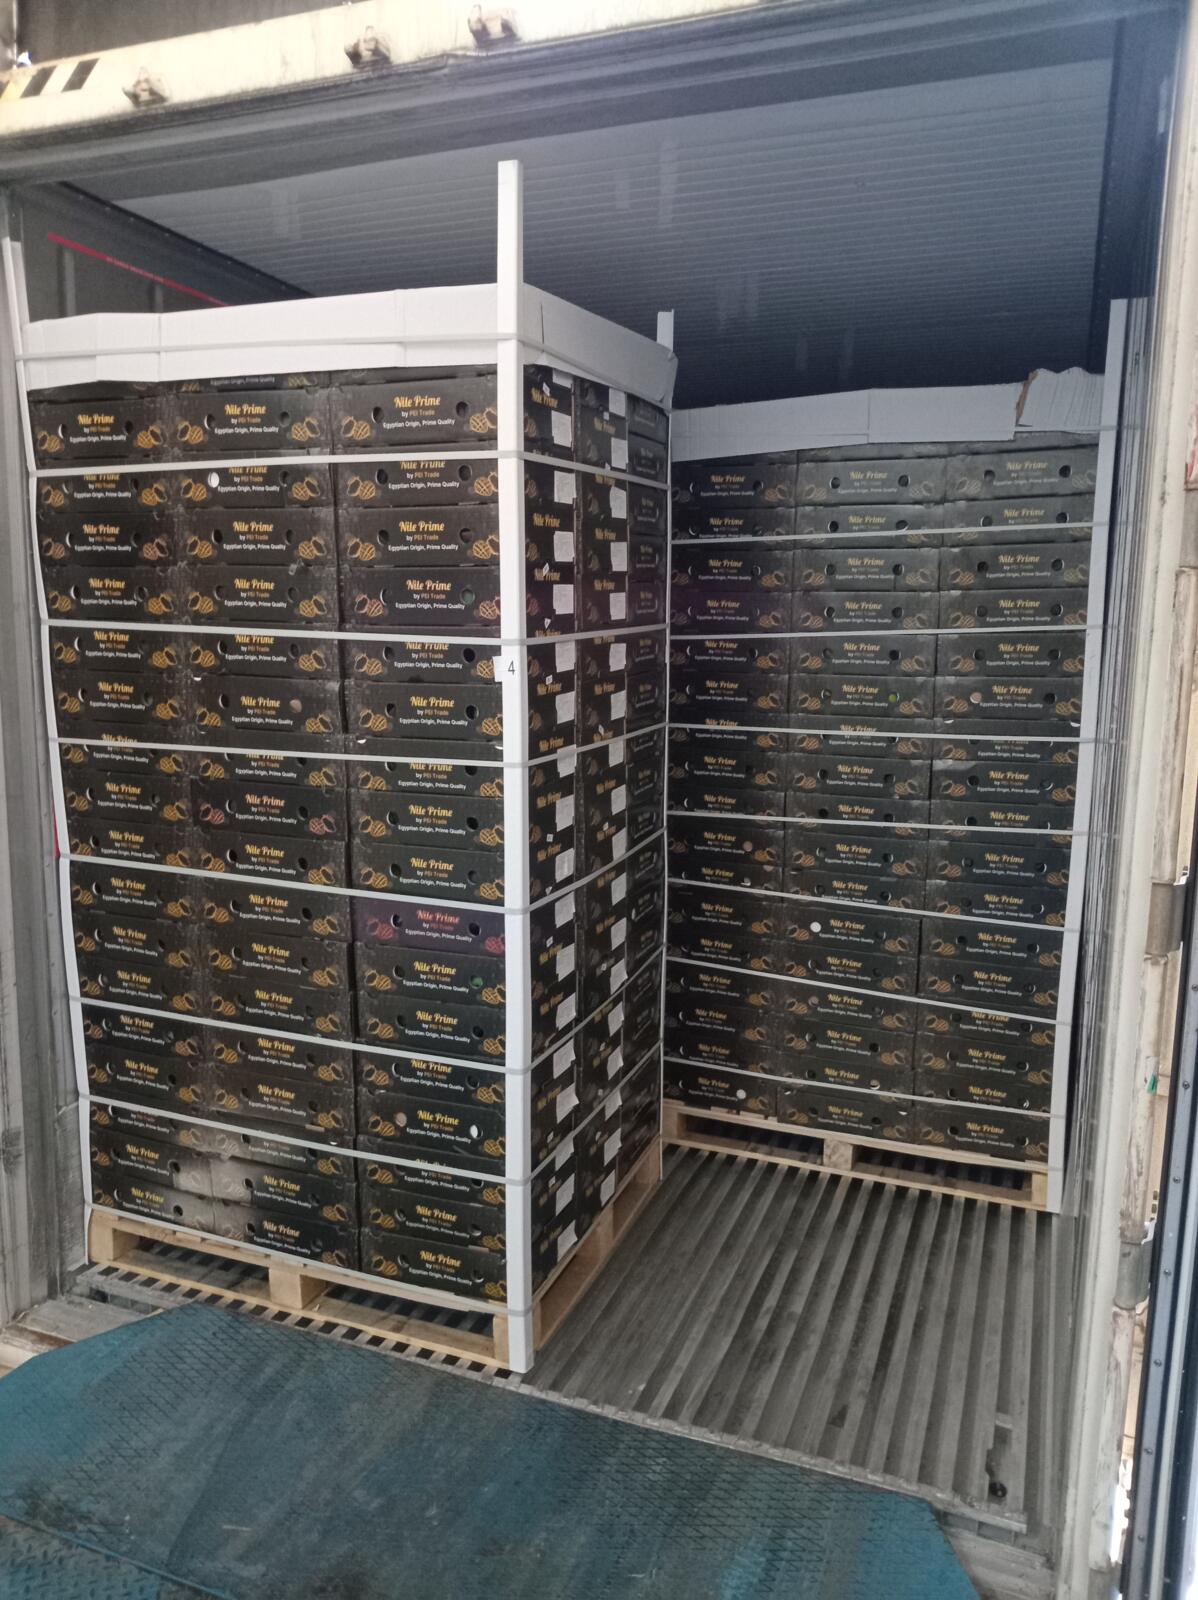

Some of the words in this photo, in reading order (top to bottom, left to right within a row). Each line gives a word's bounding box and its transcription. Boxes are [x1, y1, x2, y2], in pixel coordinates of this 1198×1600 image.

[394, 396, 412, 408] Nile
[414, 394, 441, 407] Prime
[225, 404, 241, 415] Nile
[242, 403, 266, 415] Prime
[78, 414, 92, 425] Nile
[93, 413, 115, 424] Prime
[383, 421, 405, 429] Egyptian
[437, 418, 455, 426] Quality
[215, 427, 234, 435] Egyptian
[710, 475, 724, 483] Nile
[724, 474, 746, 483] Prime
[83, 524, 97, 534] Nile
[98, 524, 120, 535] Prime
[233, 521, 248, 532] Nile
[250, 521, 274, 532] Prime
[399, 521, 416, 532] Nile
[418, 520, 445, 532] Prime
[441, 543, 458, 551] Quality
[708, 559, 722, 567] Nile
[722, 559, 743, 567] Prime
[846, 558, 862, 566] Nile
[862, 557, 886, 566] Prime
[998, 555, 1015, 563] Nile
[1015, 554, 1041, 563] Prime
[89, 578, 103, 588] Nile
[104, 578, 126, 589] Prime
[234, 578, 250, 589] Nile
[251, 579, 275, 590] Prime
[406, 579, 424, 591] Nile
[425, 579, 452, 591] Prime
[395, 602, 416, 610] Egyptian
[844, 601, 859, 610] Nile
[860, 601, 883, 610] Prime
[843, 642, 858, 651] Nile
[858, 643, 881, 651] Prime
[998, 643, 1015, 652] Nile
[1015, 643, 1041, 652] Prime
[507, 660, 516, 675] 4
[98, 681, 112, 692] Nile
[113, 682, 134, 694] Prime
[705, 680, 718, 688] Nile
[719, 680, 739, 689] Prime
[841, 684, 856, 693] Nile
[857, 685, 879, 694] Prime
[991, 685, 1008, 694] Nile
[1008, 685, 1033, 694] Prime
[241, 696, 256, 707] Nile
[257, 696, 281, 708] Prime
[410, 696, 427, 707] Nile
[429, 696, 455, 708] Prime
[399, 717, 420, 725] Egyptian
[837, 764, 852, 773] Nile
[852, 765, 874, 774] Prime
[988, 770, 1005, 779] Nile
[1005, 771, 1030, 780] Prime
[105, 782, 119, 792] Nile
[120, 783, 141, 795] Prime
[245, 794, 261, 805] Nile
[262, 795, 285, 807] Prime
[409, 804, 426, 816] Nile
[427, 805, 453, 818] Prime
[990, 811, 1006, 820] Nile
[1006, 812, 1031, 821] Prime
[398, 824, 419, 832] Egyptian
[449, 828, 466, 836] Quality
[835, 843, 850, 852] Nile
[850, 845, 873, 854] Prime
[410, 857, 427, 869] Nile
[428, 859, 454, 871] Prime
[984, 853, 1000, 862] Nile
[1001, 854, 1025, 864] Prime
[111, 877, 124, 888] Nile
[125, 879, 146, 891] Prime
[399, 877, 420, 885] Egyptian
[450, 881, 467, 889] Quality
[249, 894, 264, 905] Nile
[265, 895, 289, 908] Prime
[416, 909, 433, 921] Nile
[434, 911, 460, 925] Prime
[830, 919, 844, 928] Nile
[844, 920, 865, 930] Prime
[977, 932, 993, 941] Nile
[993, 934, 1018, 944] Prime
[252, 942, 267, 954] Nile
[268, 945, 290, 958] Prime
[826, 956, 841, 965] Nile
[841, 958, 863, 968] Prime
[414, 961, 430, 972] Nile
[431, 963, 457, 976] Prime
[117, 970, 130, 981] Nile
[131, 972, 152, 984] Prime
[973, 970, 989, 980] Nile
[989, 972, 1013, 983] Prime
[416, 1010, 432, 1022] Nile
[433, 1012, 459, 1026] Prime
[258, 1037, 272, 1049] Nile
[273, 1040, 296, 1053] Prime
[967, 1048, 983, 1058] Nile
[983, 1050, 1007, 1061] Prime
[125, 1059, 138, 1070] Nile
[139, 1062, 159, 1075] Prime
[418, 1110, 434, 1122] Nile
[435, 1112, 459, 1126] Prime
[263, 1175, 278, 1186] Nile
[279, 1178, 301, 1192] Prime
[416, 1205, 431, 1217] Nile
[433, 1208, 457, 1222] Prime
[263, 1220, 277, 1232] Nile
[278, 1224, 300, 1238] Prime
[420, 1250, 436, 1262] Nile
[437, 1253, 462, 1268] Prime
